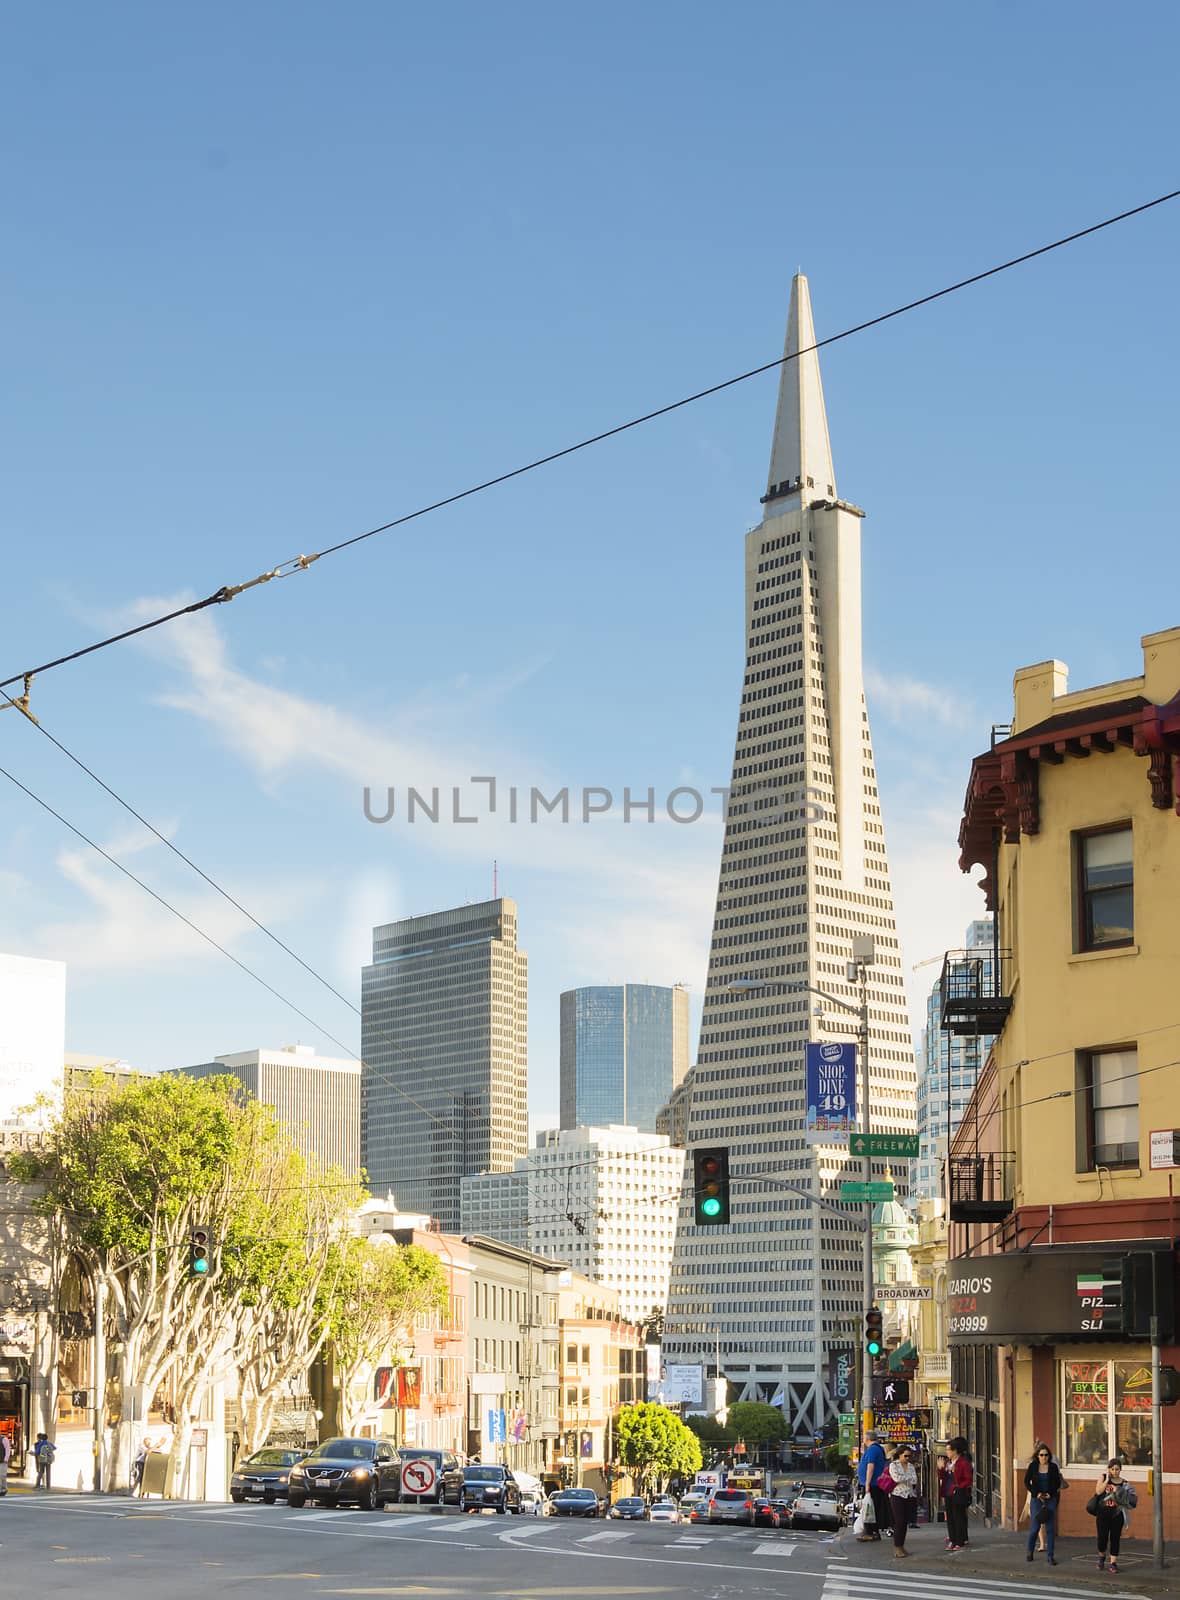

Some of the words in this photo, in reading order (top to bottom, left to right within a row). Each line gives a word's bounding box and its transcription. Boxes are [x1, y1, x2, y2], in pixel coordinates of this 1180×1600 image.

[818, 1064, 845, 1079] SHOP
[818, 1079, 845, 1095] DINE
[818, 1095, 846, 1111] 49
[870, 1140, 917, 1151] FREEWAY
[951, 1277, 993, 1295] ZARIO'S
[877, 1289, 930, 1299] BROADWAY
[1092, 1308, 1104, 1319] B
[1081, 1319, 1103, 1330] SLI
[838, 1355, 848, 1397] OPERA
[1075, 1383, 1088, 1392] BY
[1090, 1383, 1106, 1392] THE
[1073, 1395, 1108, 1409] SLICE
[697, 1476, 717, 1484] FedEx
